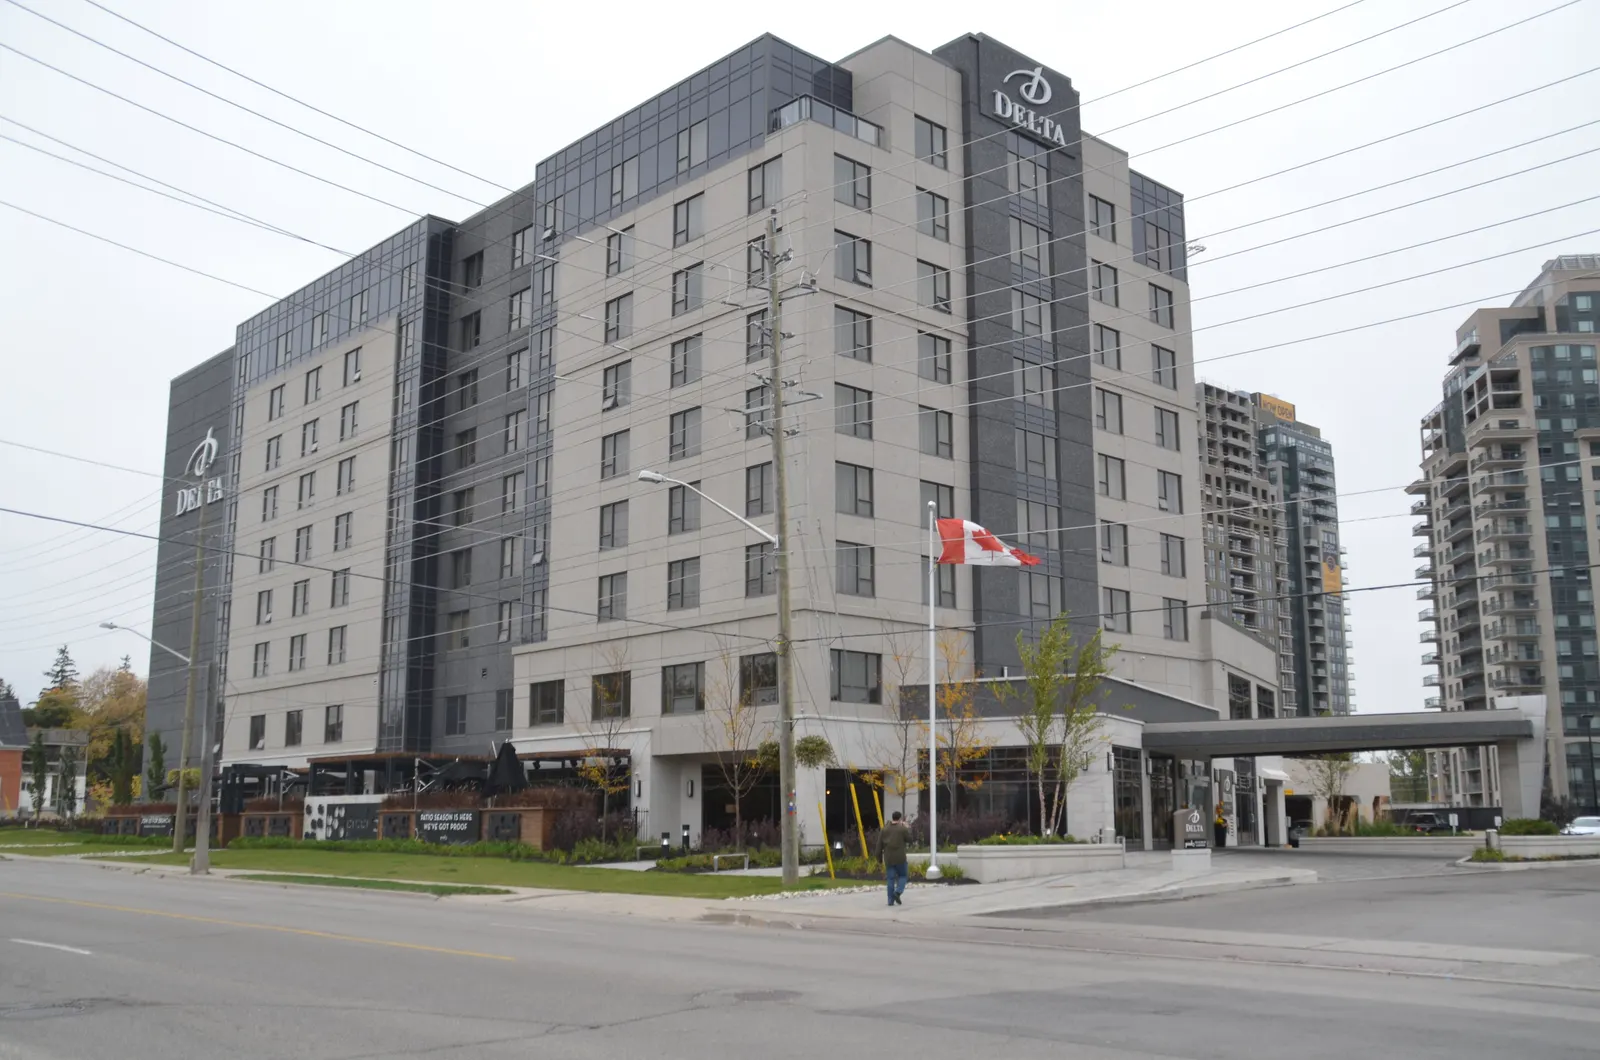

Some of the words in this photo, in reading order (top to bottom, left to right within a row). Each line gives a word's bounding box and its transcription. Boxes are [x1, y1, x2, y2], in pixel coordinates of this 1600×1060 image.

[992, 89, 1066, 146] DELTA
[420, 813, 433, 821] PATIO
[434, 813, 453, 821] SEASON
[459, 813, 472, 821] HERE
[438, 823, 449, 831] GOT
[450, 823, 467, 831] PROOF
[1185, 824, 1203, 832] DELTA
